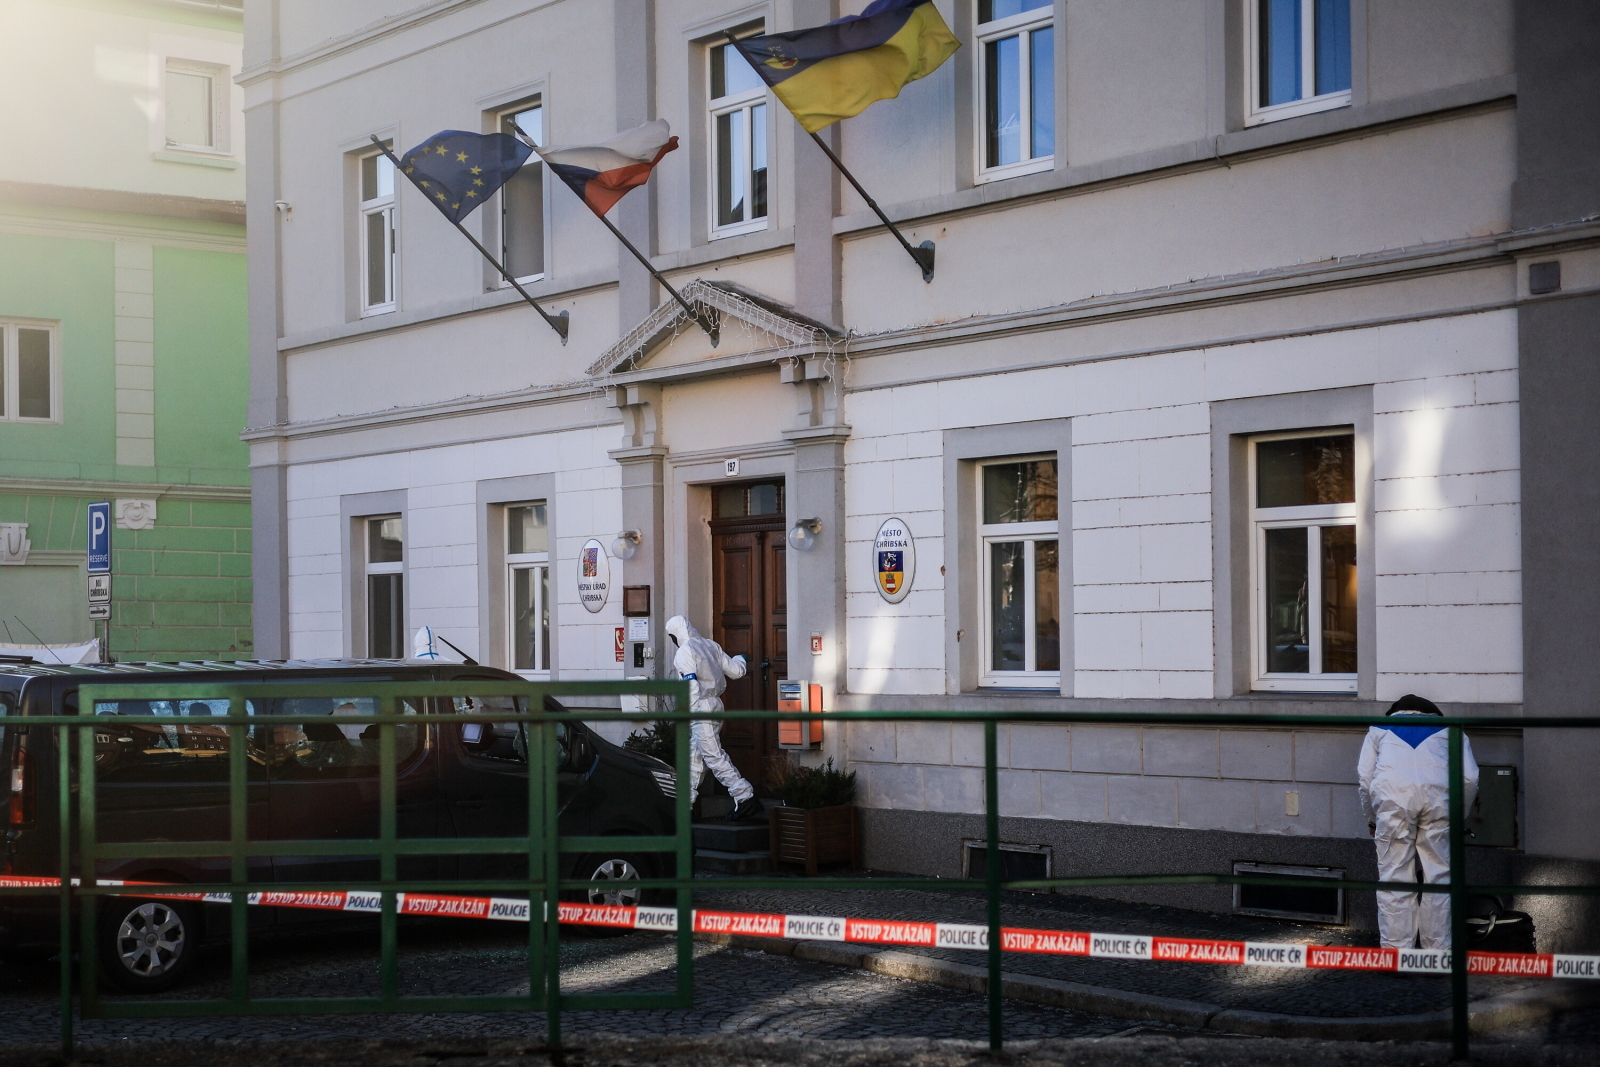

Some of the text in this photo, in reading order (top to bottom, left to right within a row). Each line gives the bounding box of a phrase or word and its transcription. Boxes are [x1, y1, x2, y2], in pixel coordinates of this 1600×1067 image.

[93, 511, 105, 549] P
[881, 528, 902, 537] MĚSTO
[876, 539, 908, 548] CHŘIBSKÁ
[266, 891, 295, 905] VSTUP
[295, 891, 342, 907] ZAKÁZÁN
[408, 898, 437, 912] VSTUP
[438, 898, 485, 915] ZAKÁZÁN
[492, 902, 528, 917] POLICIE
[558, 906, 631, 924] STUP ZAKÁZÁN
[638, 911, 675, 927] POLICIE
[700, 915, 780, 934] VSTUP ZAKÁZÁN
[788, 920, 840, 936] POLICIE ČR
[850, 923, 931, 943] VSTUP ZAKÁZÁN
[939, 928, 976, 945] POLICIE
[1003, 933, 1085, 952] VSTUP ZAKÁZÁN
[1094, 938, 1147, 955] POLICIE ČR
[1157, 942, 1239, 961] VSTUP ZAKÁZÁN
[1248, 947, 1301, 963] POLICIE ČR
[1312, 950, 1393, 968] VSTUP ZAKÁZÁN
[1401, 954, 1438, 969] POLICIE
[1499, 956, 1548, 974] ZAKÁZÁN
[1556, 959, 1594, 976] POLICIE
